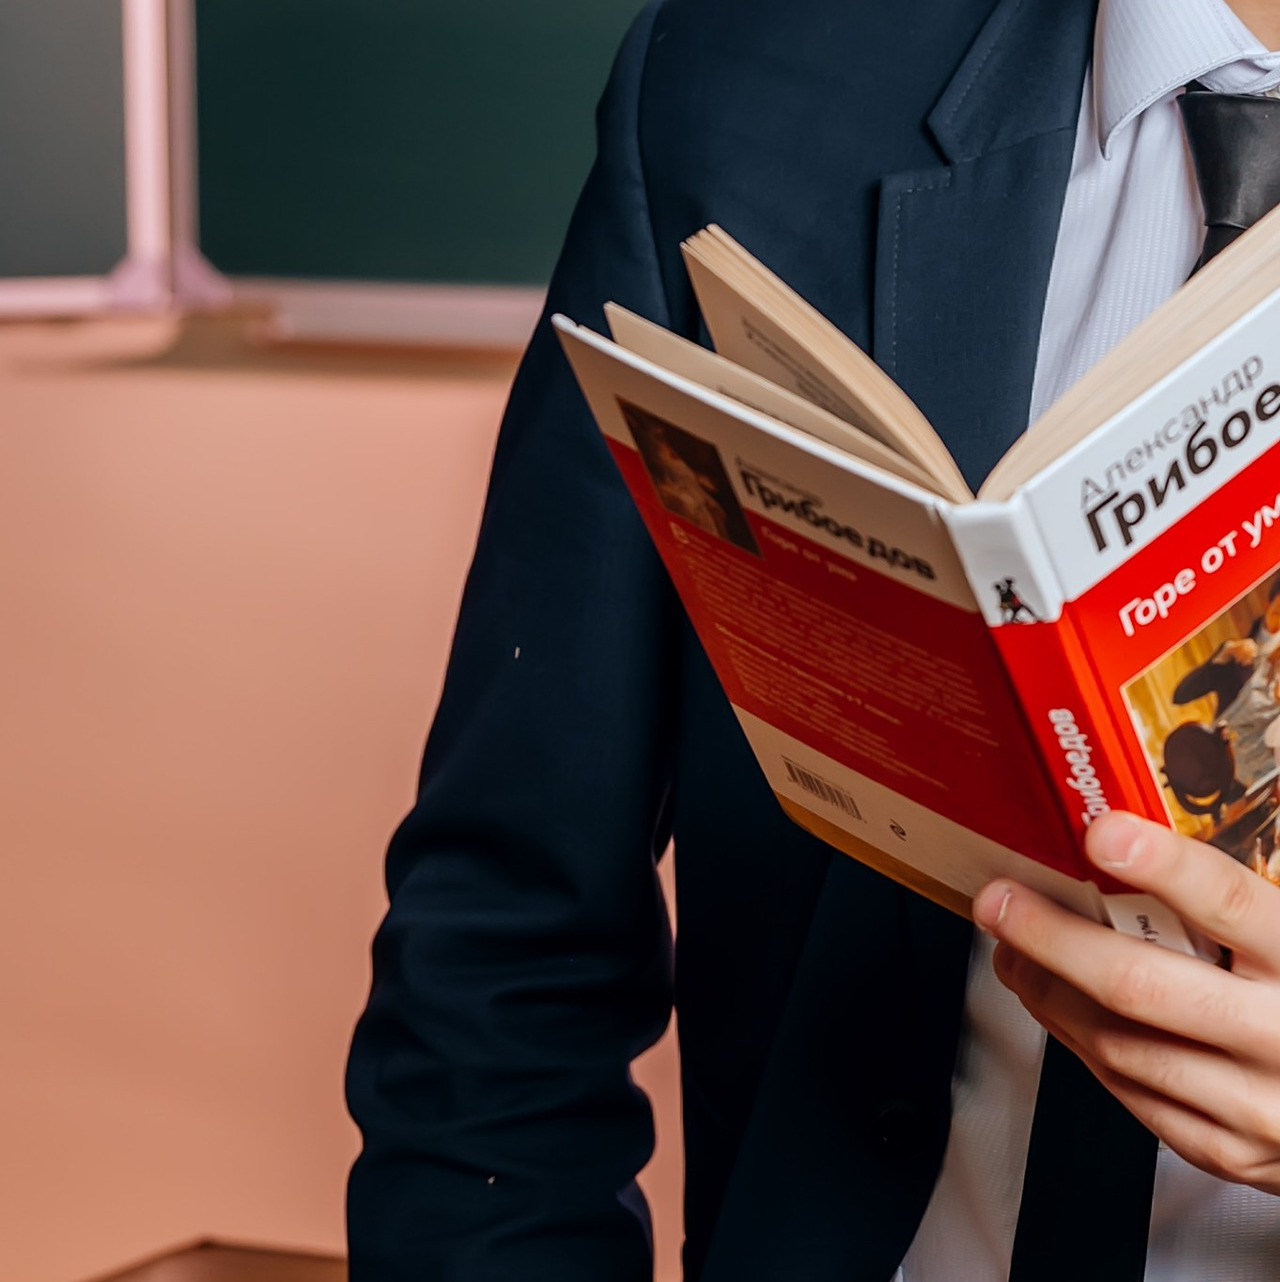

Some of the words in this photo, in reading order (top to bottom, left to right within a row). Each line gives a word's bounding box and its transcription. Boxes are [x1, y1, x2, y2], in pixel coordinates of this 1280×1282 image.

[1081, 355, 1263, 508] Александр
[1119, 568, 1196, 637] Горе
[1201, 530, 1238, 573] от
[1048, 708, 1111, 826] рибоедов
